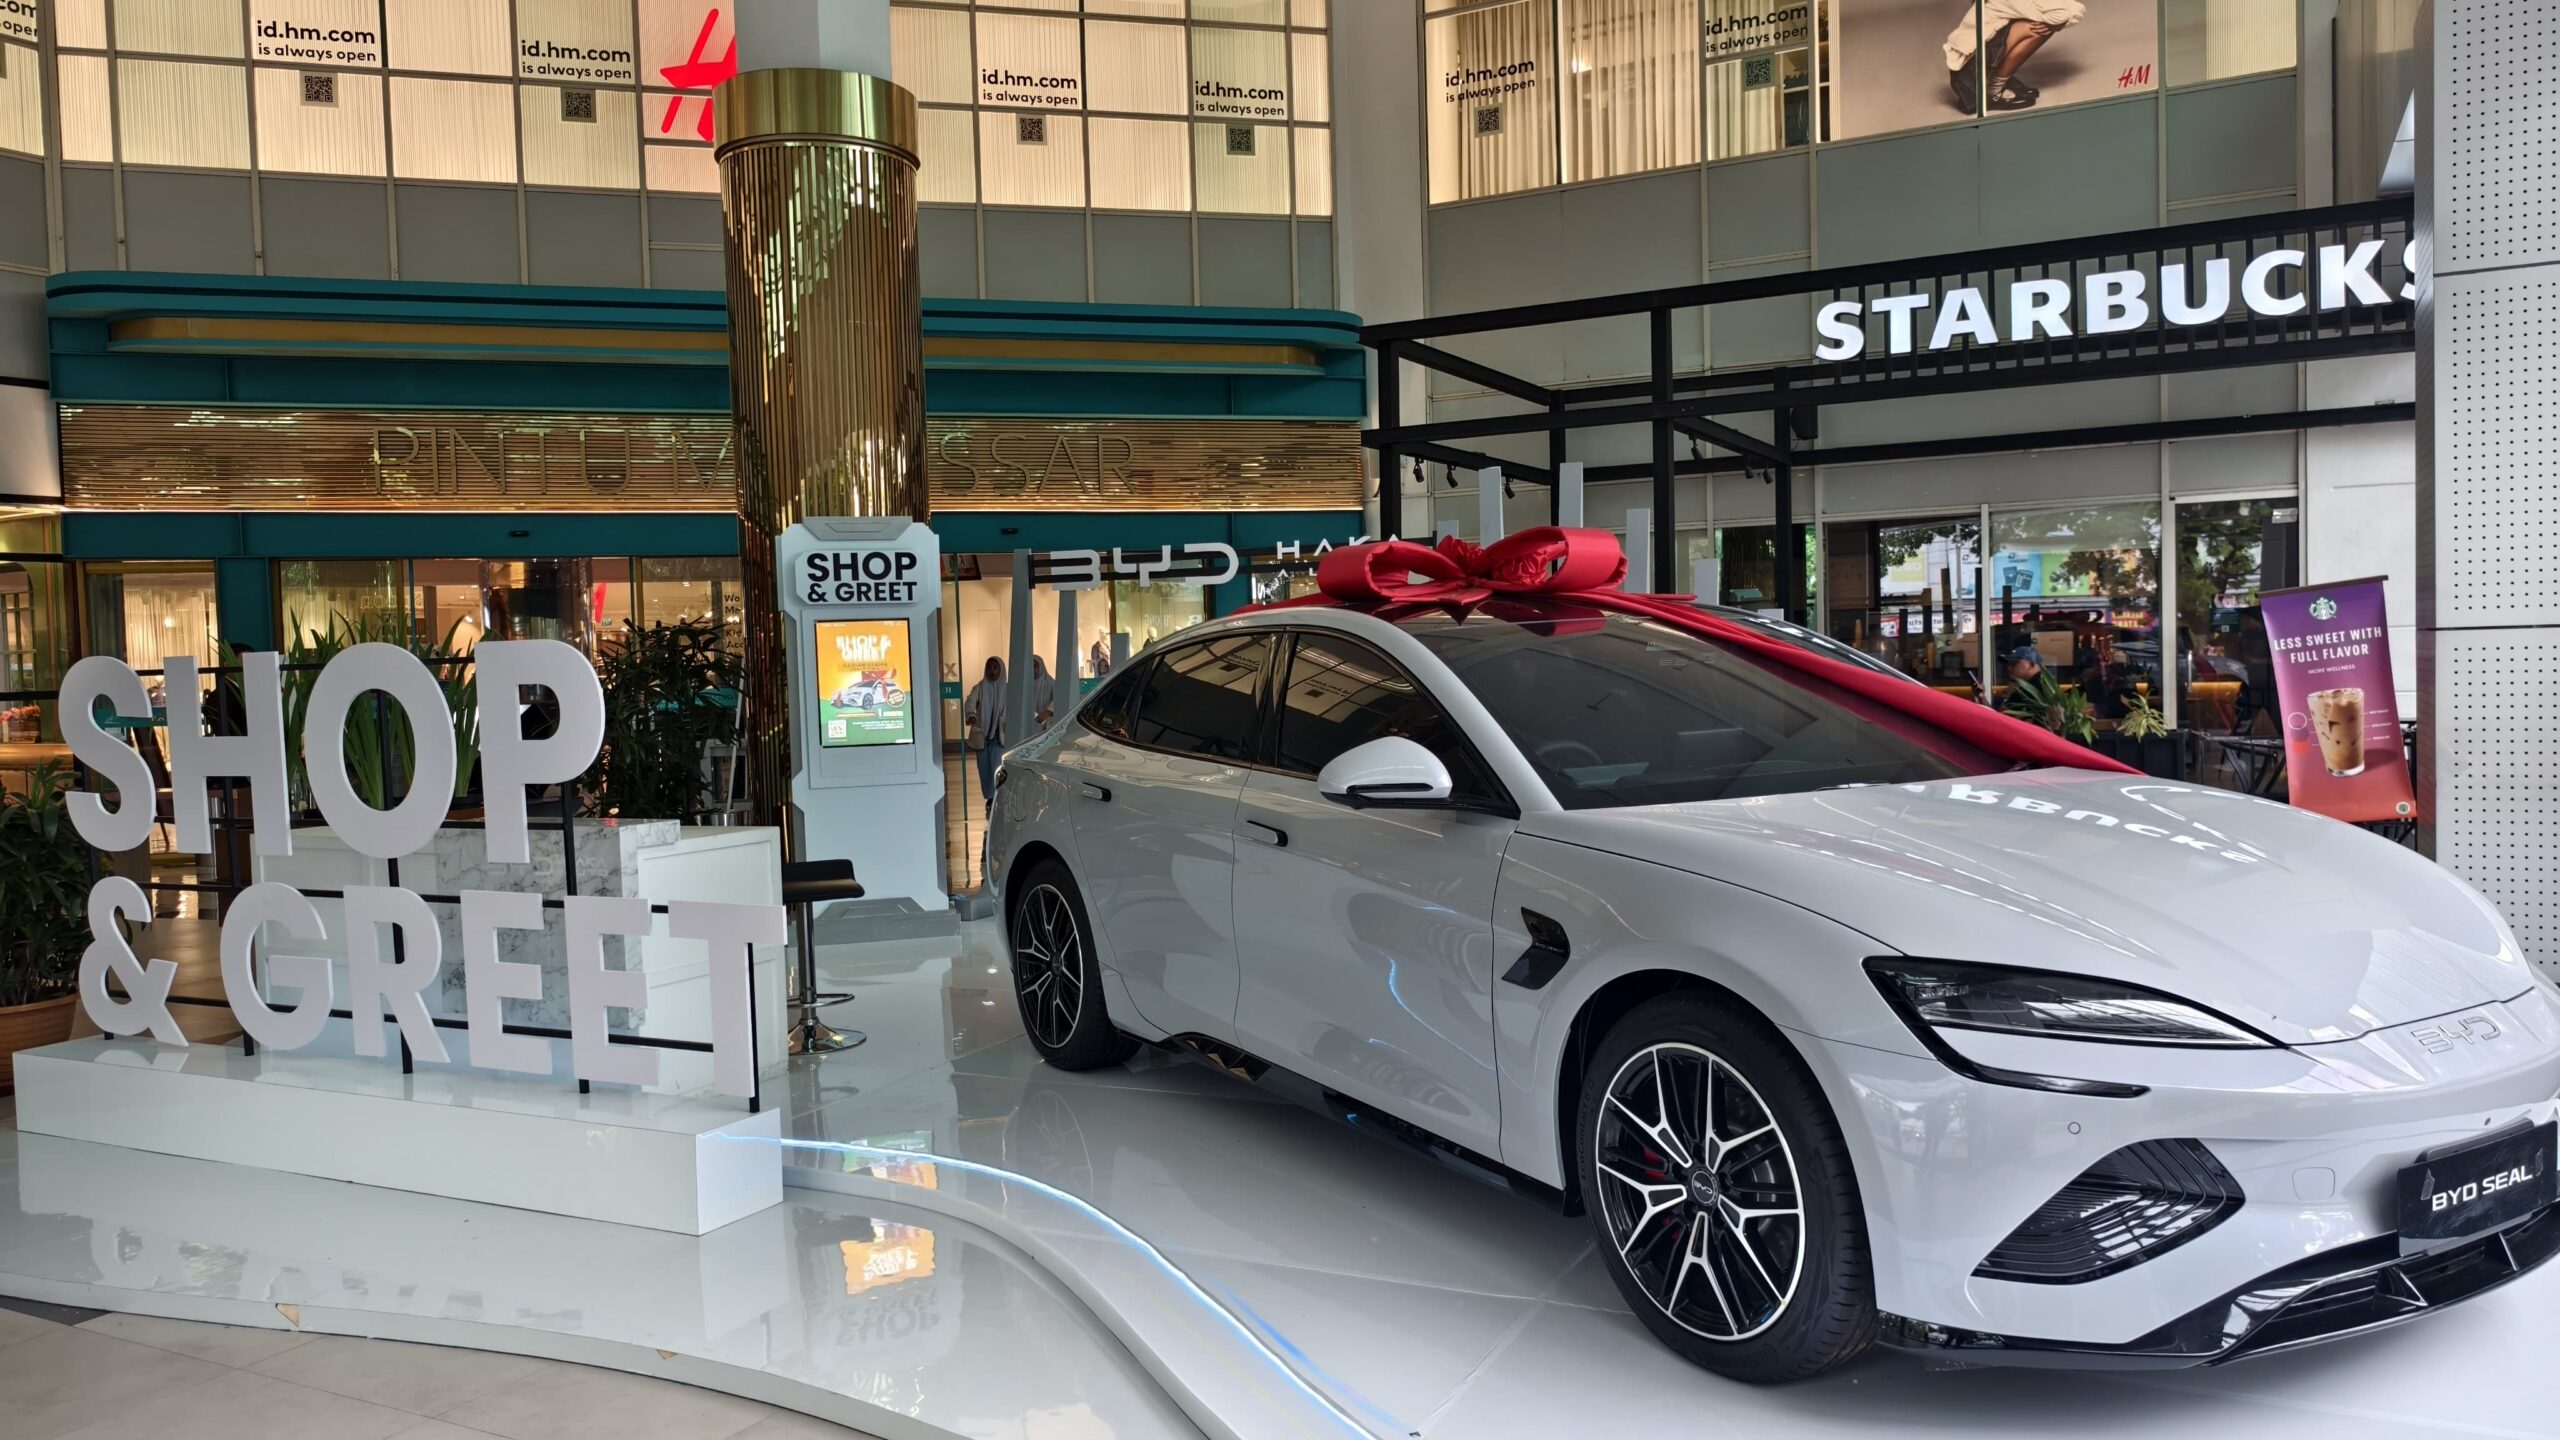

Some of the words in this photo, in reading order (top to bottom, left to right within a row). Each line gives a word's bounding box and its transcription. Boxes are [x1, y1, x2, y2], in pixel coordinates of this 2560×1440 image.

[257, 20, 375, 44] id.hm.com
[1706, 6, 1808, 36] id.hm.com
[521, 40, 631, 63] id.hm.com
[1706, 42, 1716, 53] is
[1720, 34, 1770, 50] always
[1773, 26, 1808, 41] open
[258, 43, 270, 55] is
[274, 45, 333, 61] always
[336, 51, 376, 63] open
[522, 61, 534, 73] is
[537, 63, 591, 79] always
[594, 69, 631, 80] open
[982, 68, 1077, 89] id.hm.com
[1446, 60, 1534, 87] id.hm.com
[983, 89, 992, 100] is
[995, 90, 1043, 105] always
[1046, 96, 1078, 106] open
[1195, 80, 1284, 101] id.hm.com
[1446, 92, 1455, 103] is
[1458, 85, 1501, 101] always
[1504, 79, 1535, 94] open
[1195, 100, 1205, 111] is
[1208, 101, 1251, 116] always
[1254, 106, 1284, 117] open
[1814, 239, 2415, 362] STARBUCK
[372, 426, 630, 496] PINTU
[807, 551, 918, 582] SHOP
[1050, 541, 1239, 591] BYD
[807, 582, 829, 603] &
[835, 581, 918, 602] GREET
[2273, 636, 2302, 651] LESS
[2306, 631, 2346, 647] SWEET
[2349, 626, 2383, 641] WITH
[2290, 649, 2319, 664] FULL
[2322, 643, 2369, 660] FLAVOR
[2326, 664, 2356, 673] WELLNESS
[58, 638, 606, 864] SHOP
[78, 876, 189, 1047] &
[219, 882, 788, 1098] GREET
[2410, 1016, 2501, 1054] BYD
[2432, 1182, 2478, 1212] BYD
[2482, 1165, 2534, 1195] SEAL
